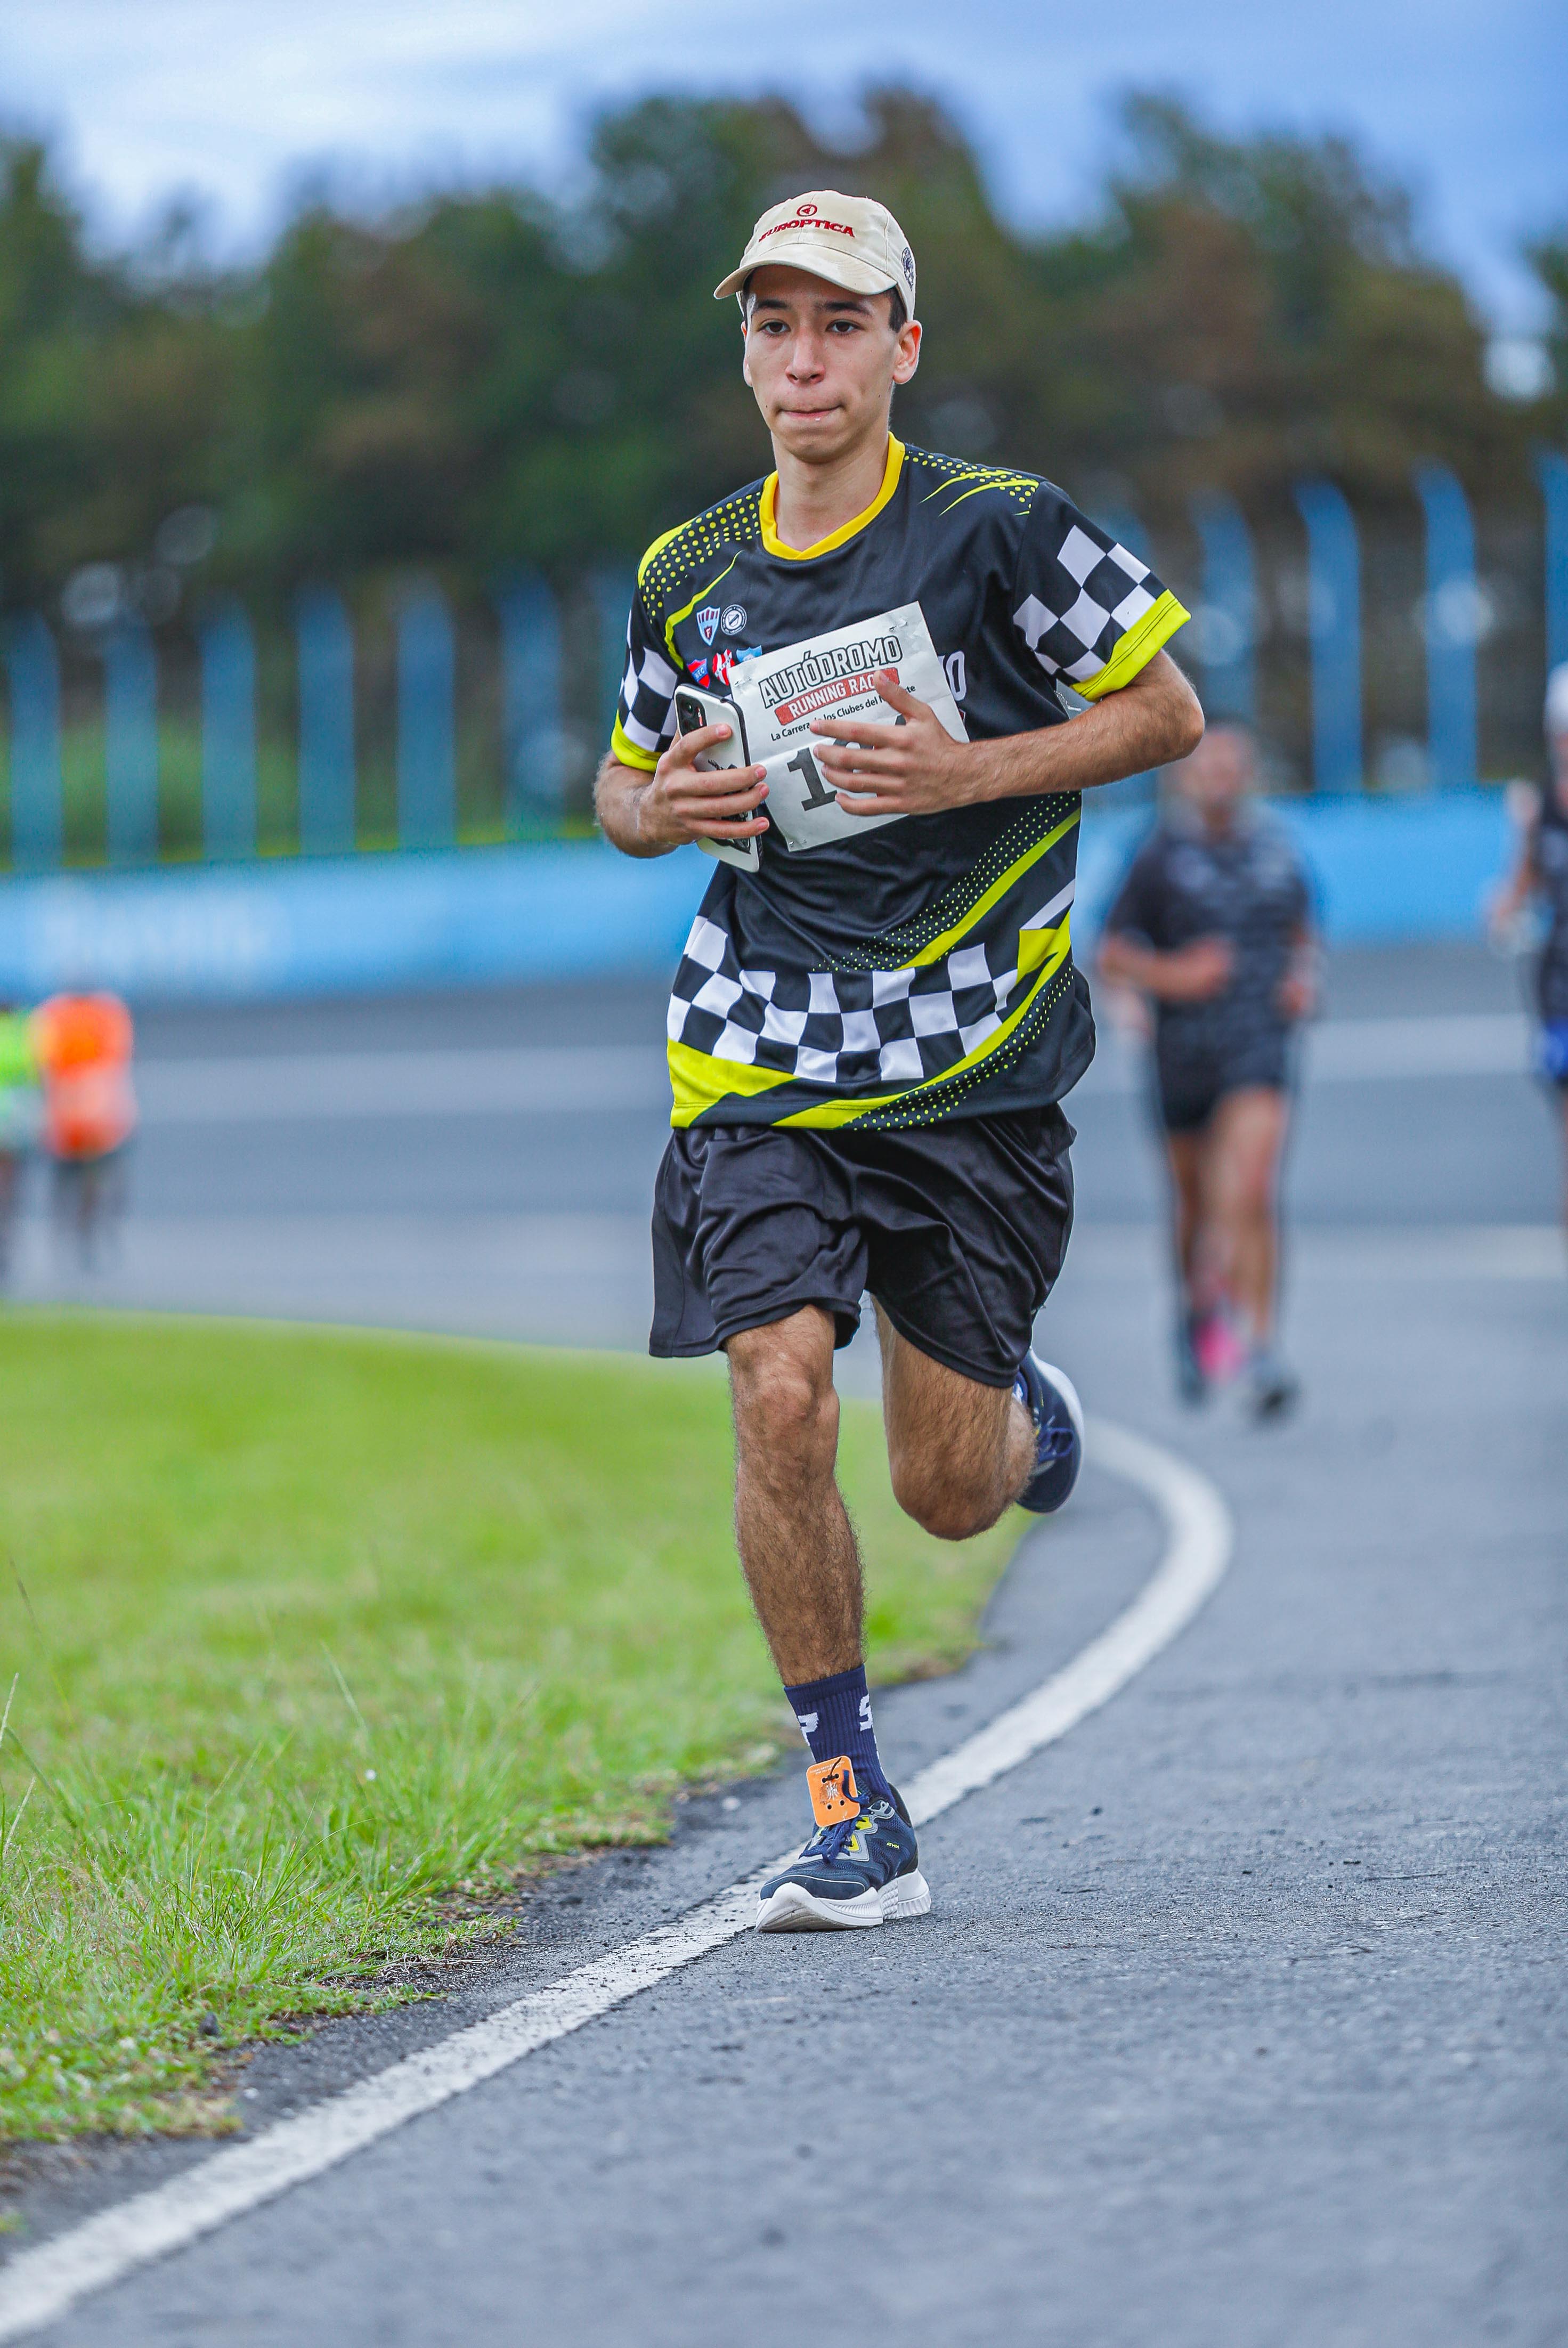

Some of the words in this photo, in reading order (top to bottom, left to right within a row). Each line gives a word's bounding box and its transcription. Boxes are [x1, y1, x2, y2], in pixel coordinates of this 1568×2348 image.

[758, 635, 903, 709] AUTÓDROMO
[770, 733, 781, 742] La
[782, 722, 810, 737] Carrera
[836, 703, 864, 717] Clubes
[865, 696, 879, 708] del
[787, 681, 847, 719] RUNNING
[848, 673, 876, 694] RAC
